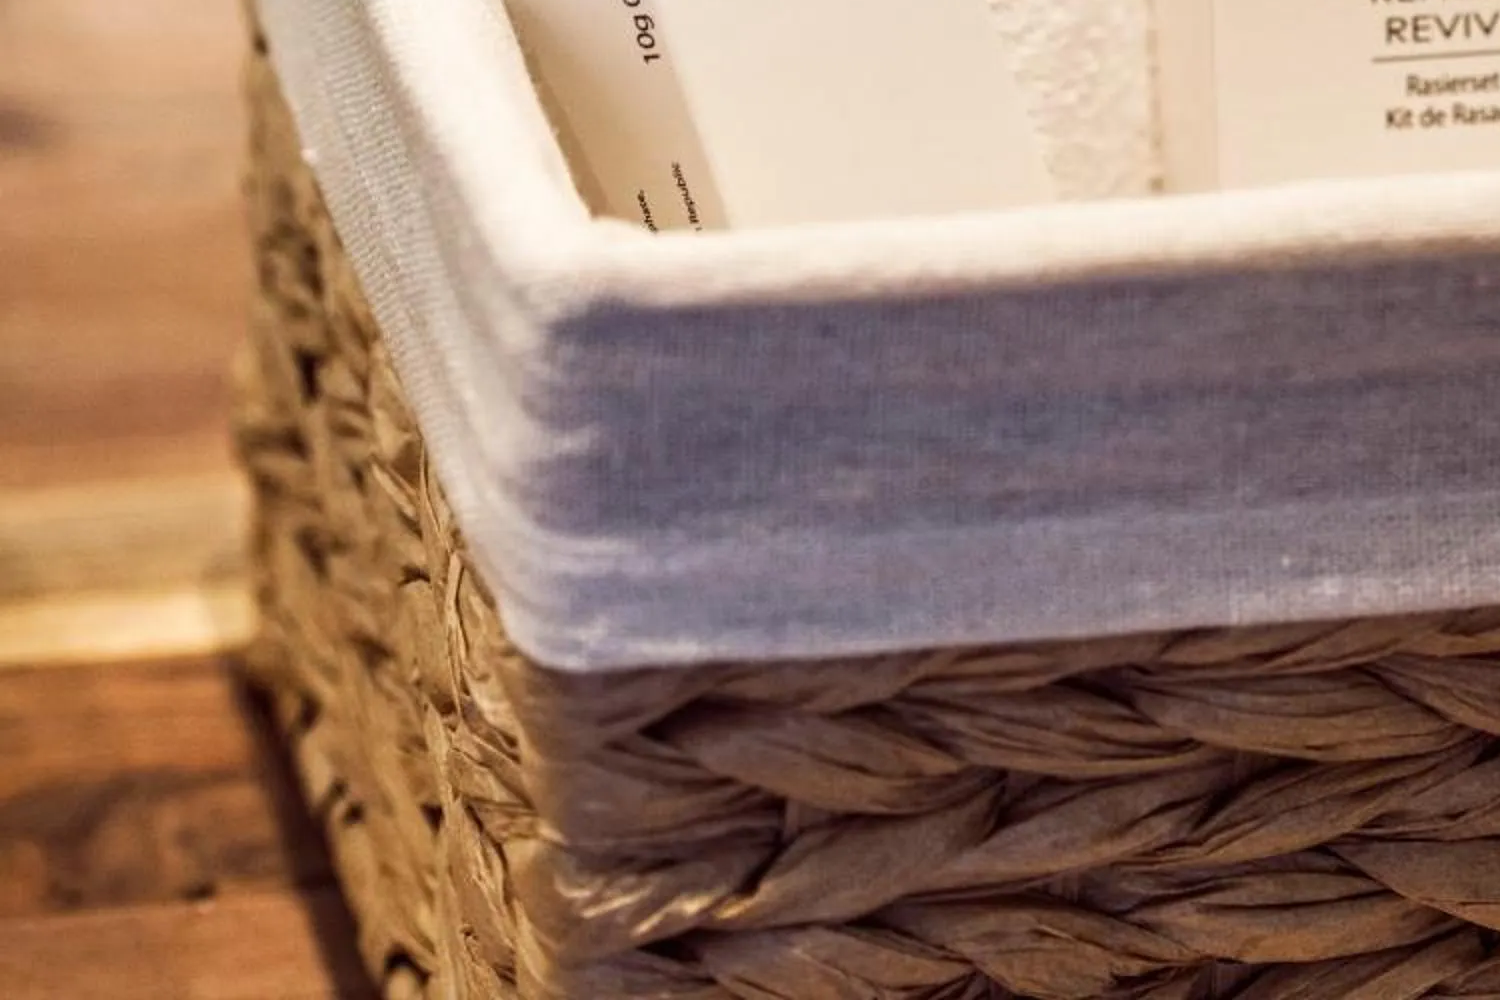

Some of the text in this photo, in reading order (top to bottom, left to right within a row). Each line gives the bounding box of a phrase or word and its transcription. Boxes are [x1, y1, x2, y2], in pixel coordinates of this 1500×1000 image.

[634, 13, 660, 64] 10g
[1406, 72, 1500, 97] Rasierset
[1385, 108, 1413, 129] Kit
[1420, 106, 1447, 128] de
